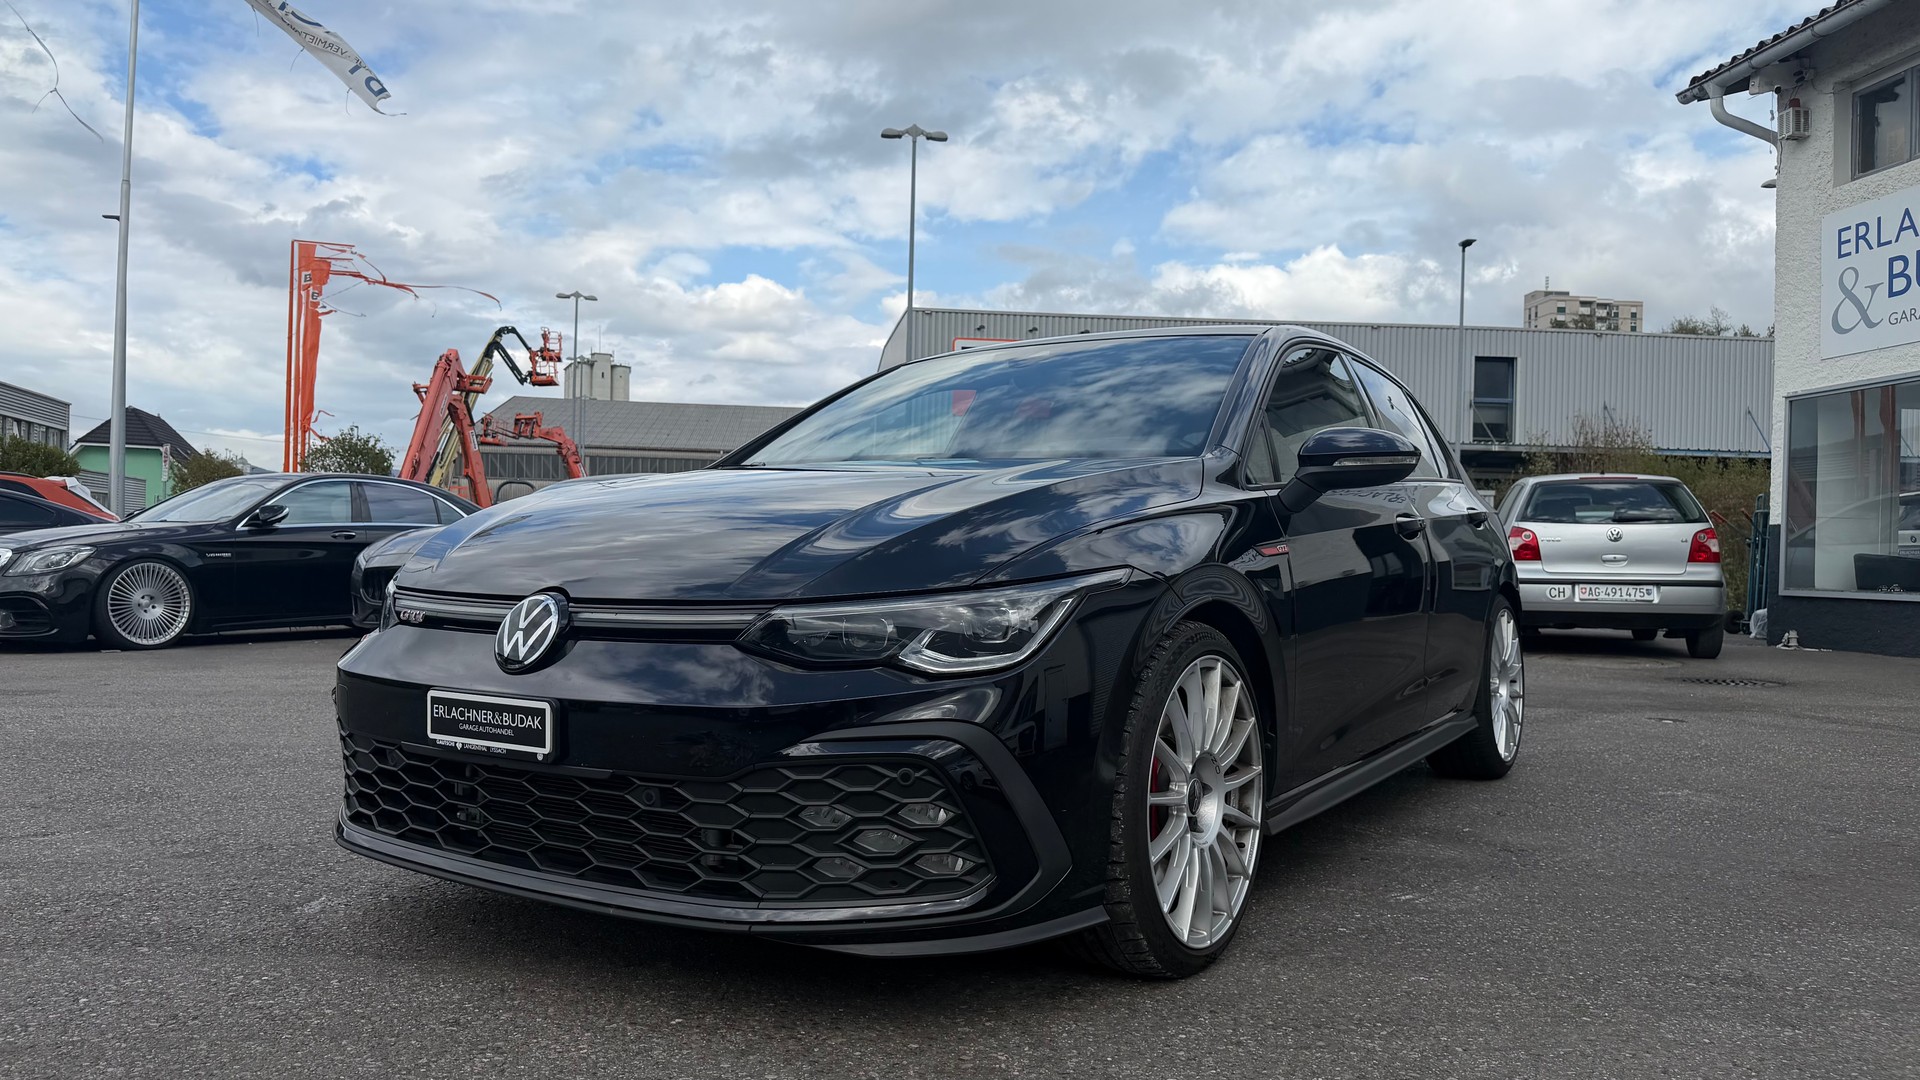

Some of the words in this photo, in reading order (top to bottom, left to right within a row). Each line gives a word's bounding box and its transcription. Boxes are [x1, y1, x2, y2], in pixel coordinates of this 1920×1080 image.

[1831, 266, 1885, 335] &
[1549, 586, 1566, 599] CH
[399, 609, 426, 623] GTI
[433, 704, 543, 730] ERLACHNER&BUDAK
[458, 722, 479, 732] GARAGE
[479, 725, 515, 737] AUTOHANDEL
